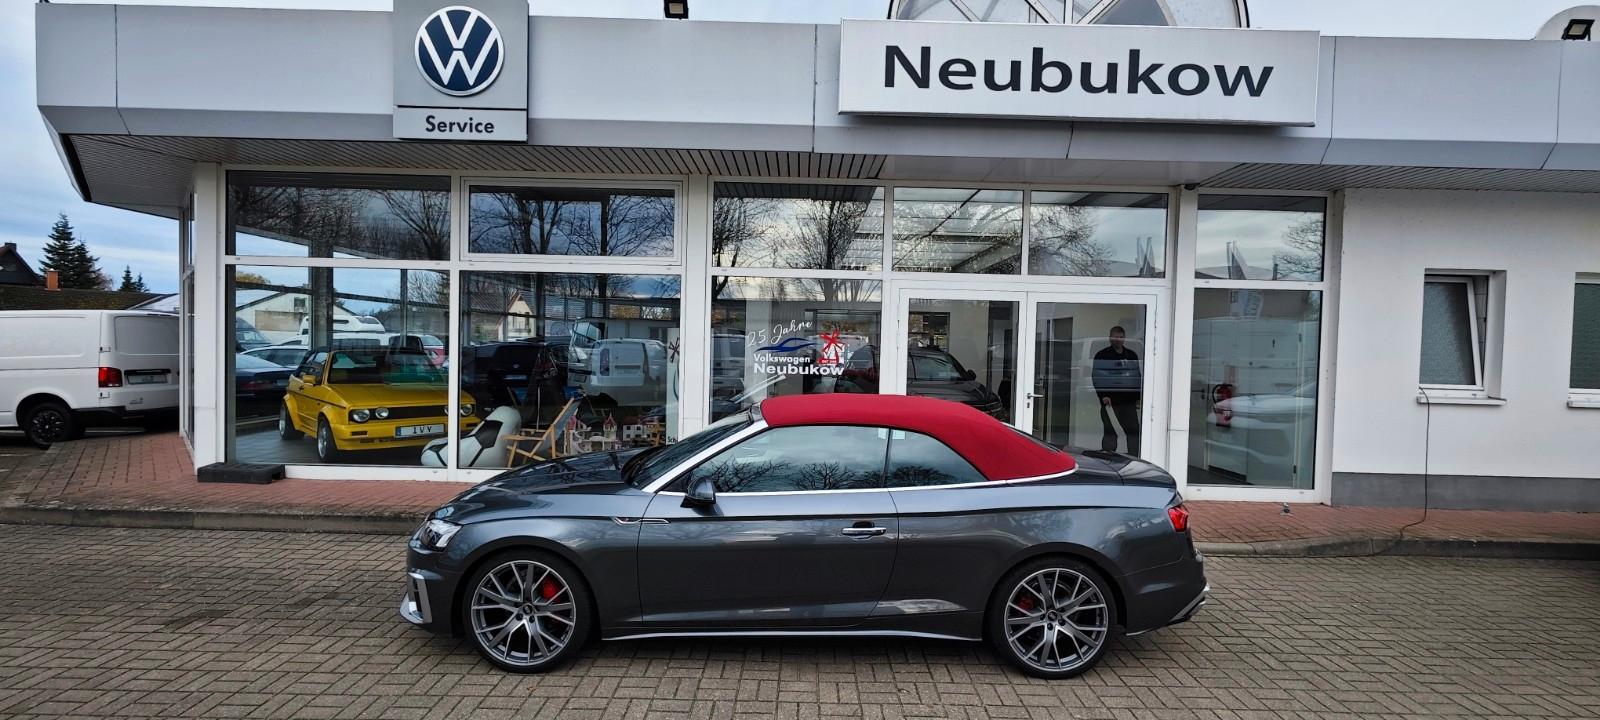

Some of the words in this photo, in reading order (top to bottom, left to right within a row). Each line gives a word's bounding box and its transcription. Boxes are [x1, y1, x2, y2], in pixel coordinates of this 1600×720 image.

[416, 6, 503, 94] VW
[884, 44, 1275, 98] Neubukow
[425, 114, 495, 134] Service
[747, 328, 766, 347] 25
[770, 319, 813, 345] Jahre
[753, 353, 811, 365] Volkswagen
[753, 362, 845, 376] Neubukow
